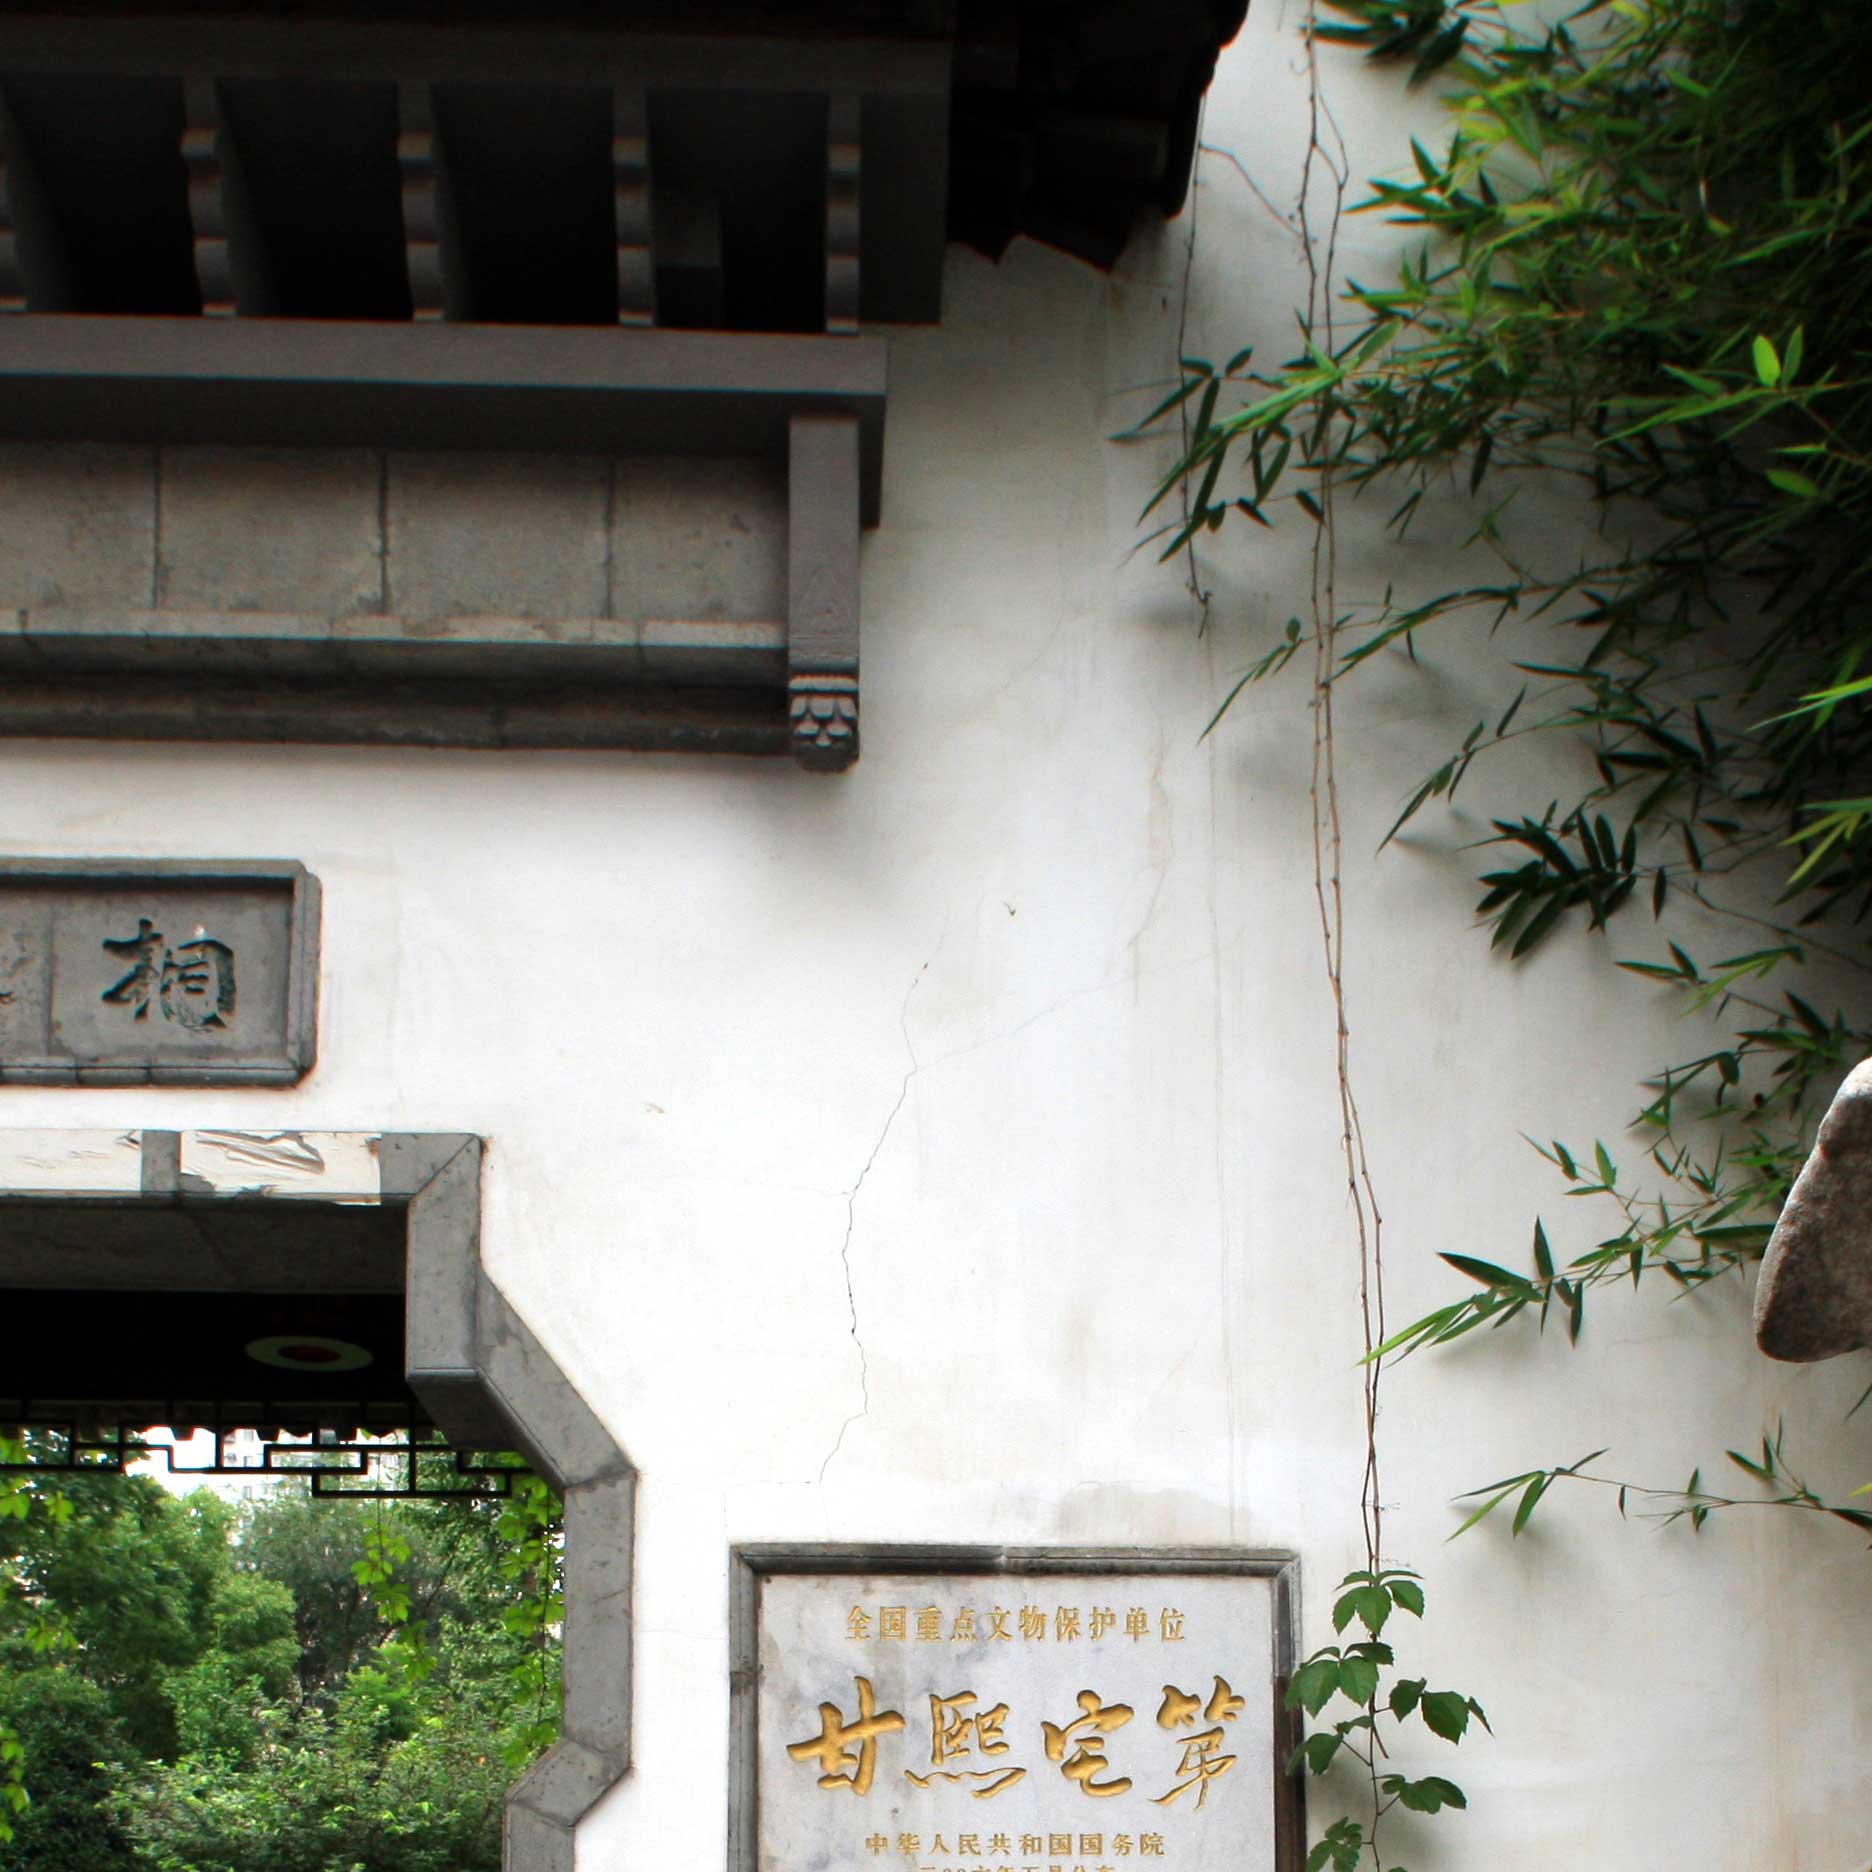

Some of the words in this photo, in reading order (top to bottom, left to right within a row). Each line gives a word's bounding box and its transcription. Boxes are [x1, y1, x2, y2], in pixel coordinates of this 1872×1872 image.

[844, 1605, 1186, 1642] 全国重点文物保护单位
[786, 1674, 1246, 1812] 甘熙宅第
[865, 1832, 1166, 1857] 中华人民共和国国务院
